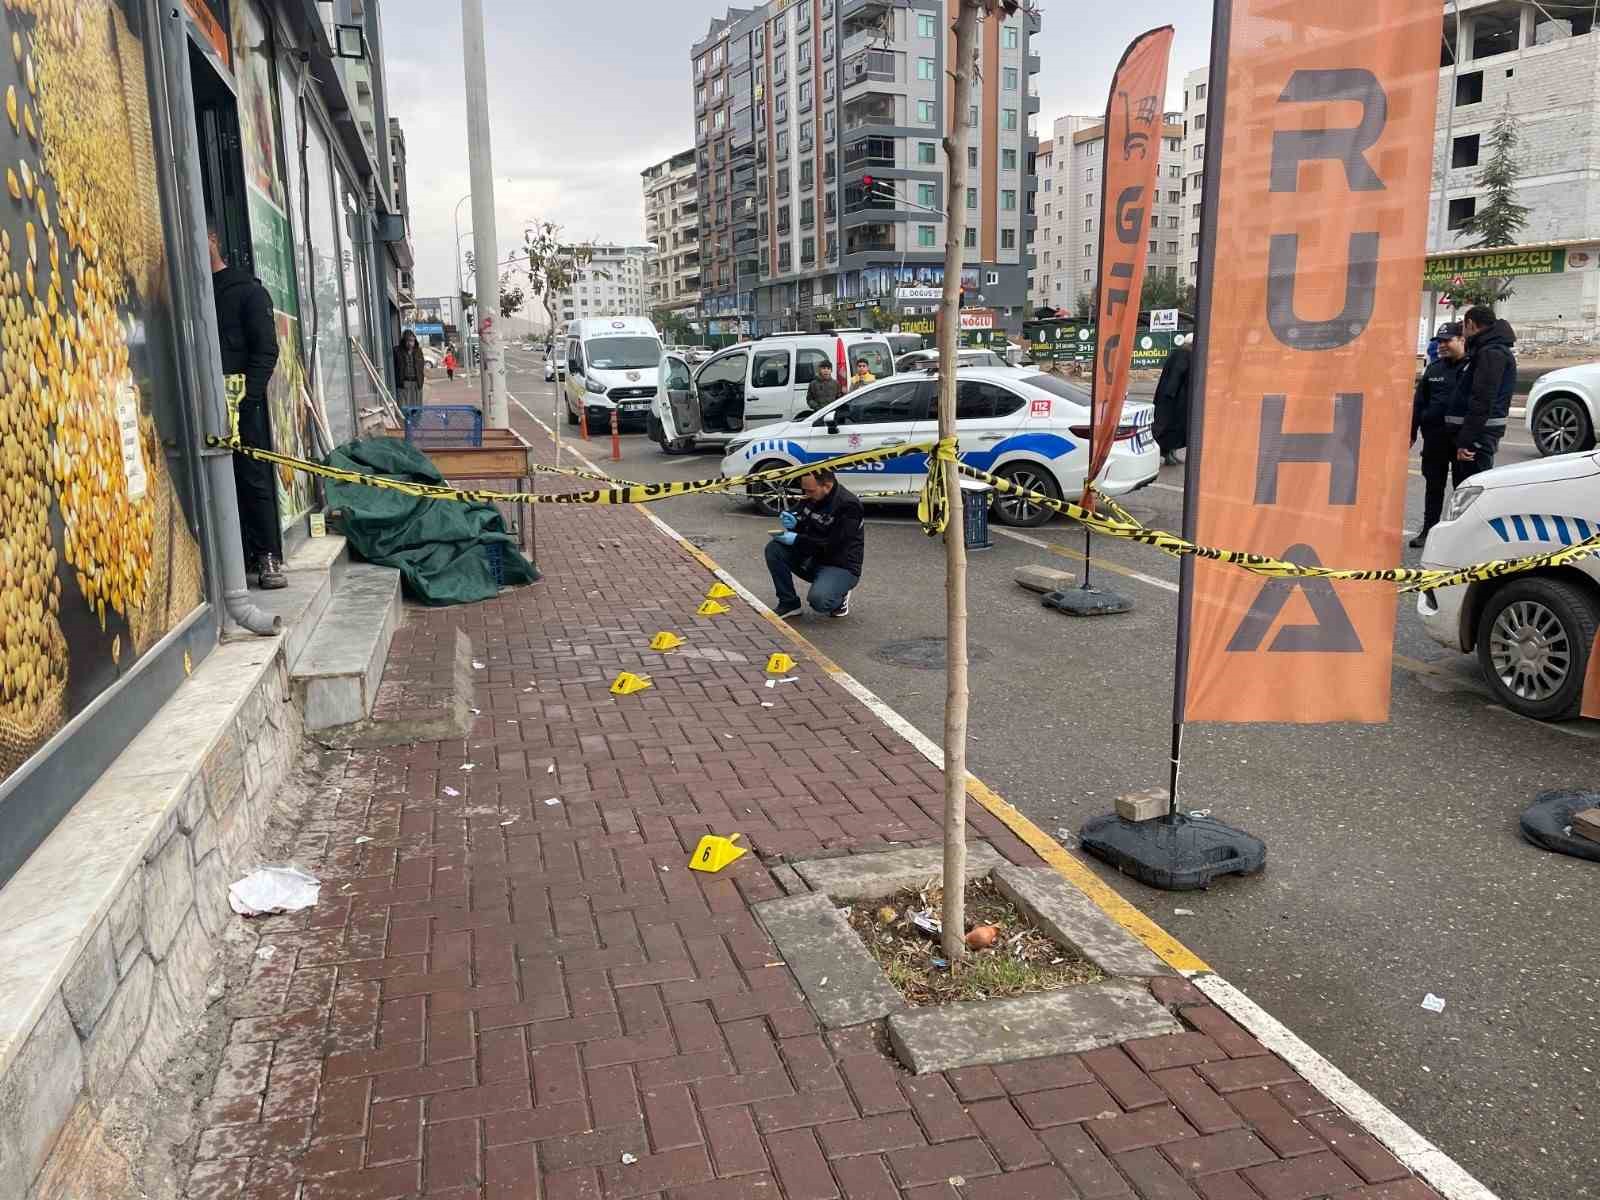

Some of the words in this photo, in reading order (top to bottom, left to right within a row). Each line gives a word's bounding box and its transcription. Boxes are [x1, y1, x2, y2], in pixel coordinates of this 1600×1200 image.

[1424, 259, 1458, 273] FALI
[1463, 251, 1553, 270] KARPUZCU
[1225, 67, 1388, 653] RUHA
[1034, 401, 1049, 410] 112
[774, 659, 781, 670] 5
[617, 678, 625, 689] 4
[702, 846, 712, 862] 6
